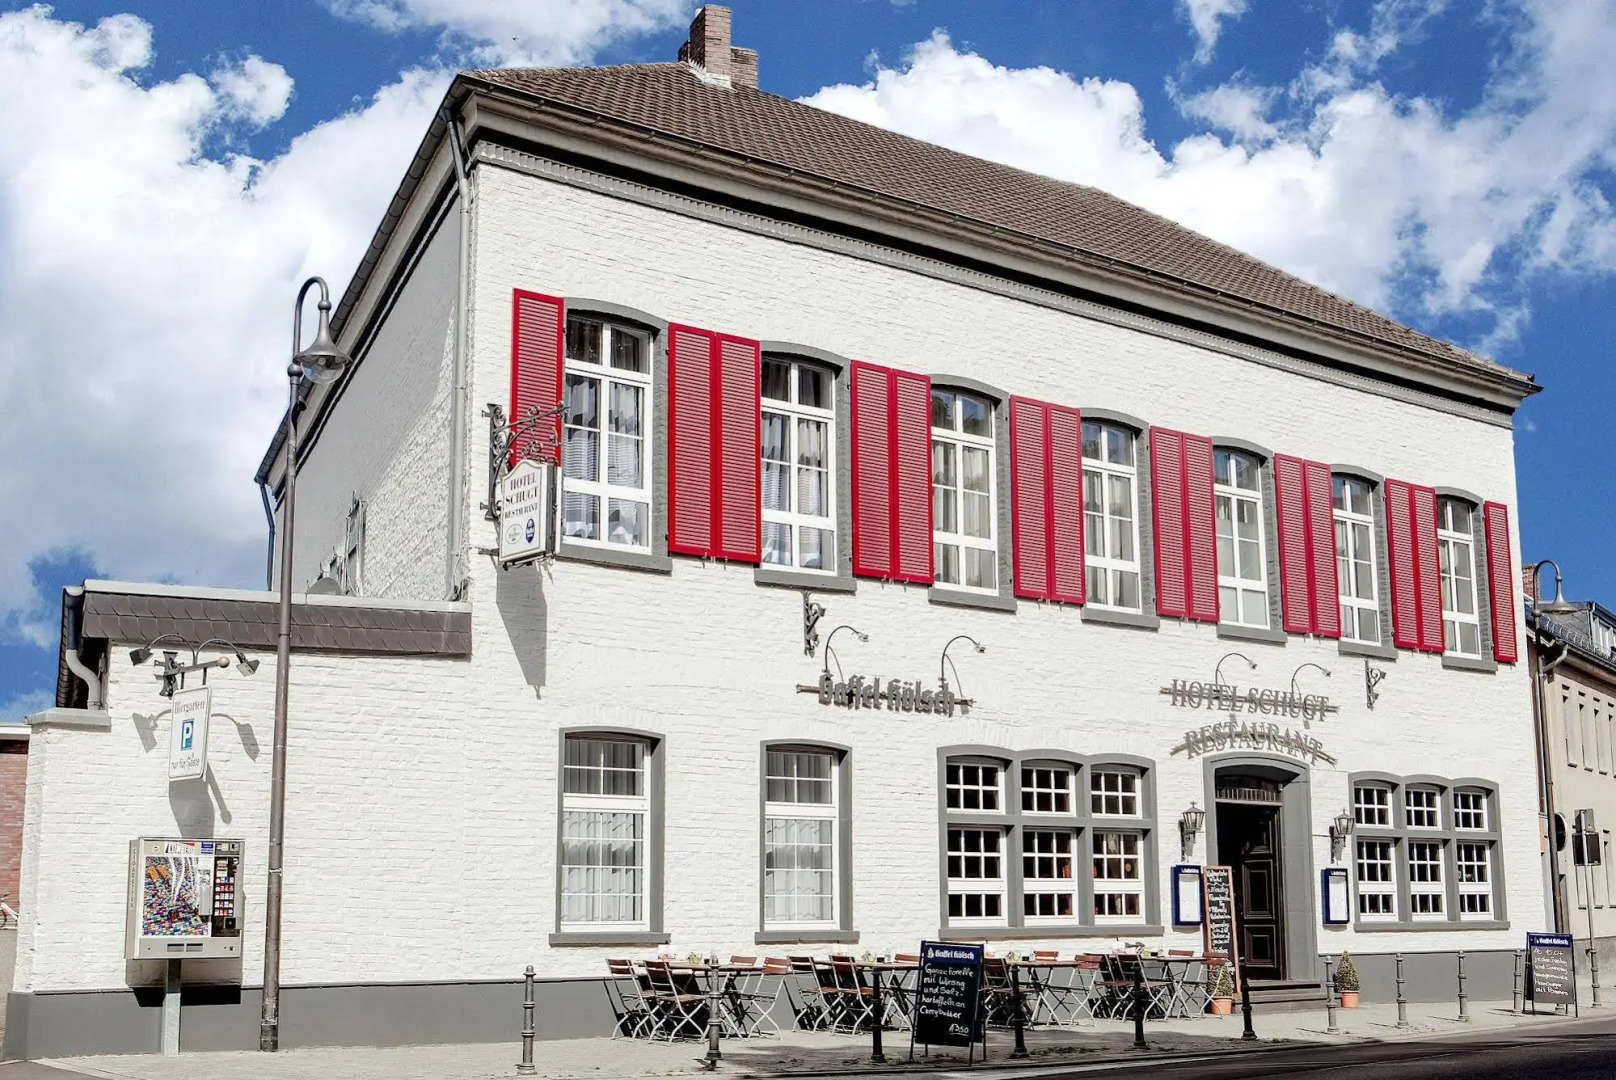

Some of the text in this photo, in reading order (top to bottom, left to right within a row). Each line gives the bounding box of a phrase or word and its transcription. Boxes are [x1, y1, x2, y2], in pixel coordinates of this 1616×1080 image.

[510, 472, 537, 491] HOTEL
[505, 486, 539, 506] SCHUGT
[504, 502, 538, 519] RESTAURANT
[1171, 679, 1329, 721] HOTEL SCHUGT
[182, 722, 192, 748] P
[1184, 721, 1323, 764] RESTAURANT
